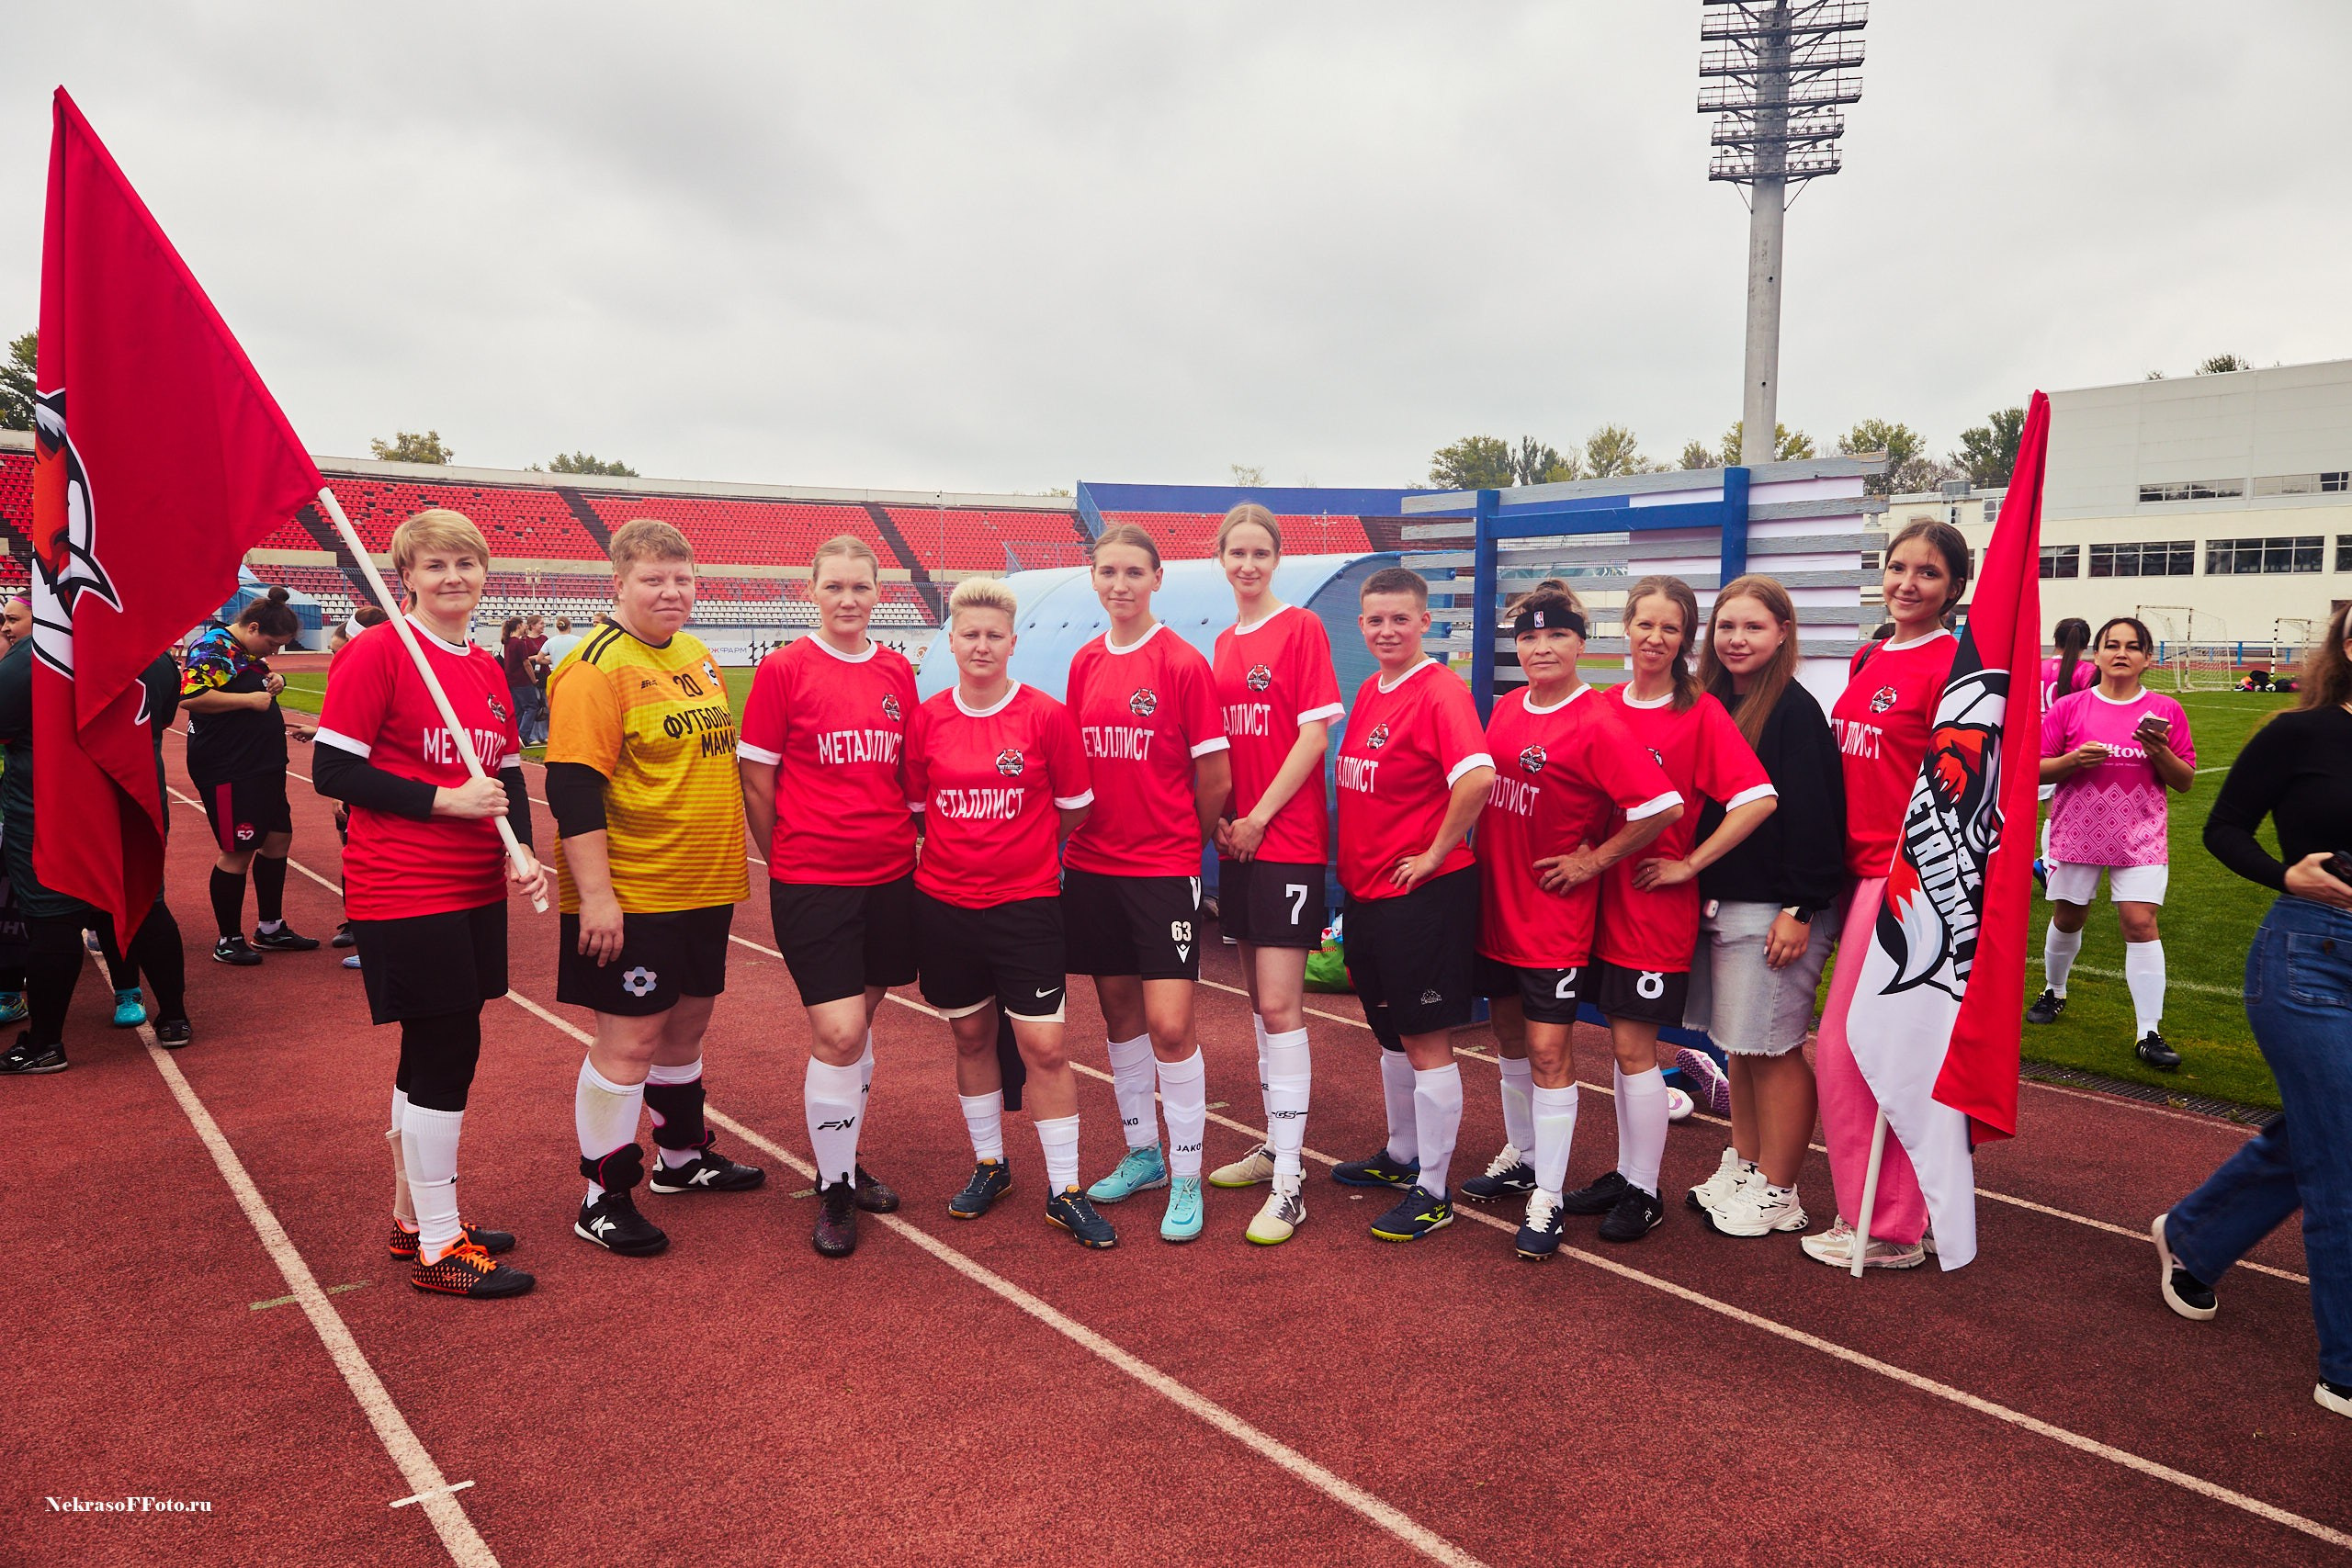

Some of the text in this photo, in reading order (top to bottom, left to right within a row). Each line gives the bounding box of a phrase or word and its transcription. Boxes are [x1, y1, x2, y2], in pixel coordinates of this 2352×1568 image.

[673, 673, 704, 697] 20
[1220, 703, 1271, 736] АЛЛИСТ
[237, 829, 254, 840] 52
[1285, 884, 1308, 925] 7
[1170, 920, 1192, 942] 63
[1555, 967, 1577, 999] 2
[1636, 970, 1665, 999] 8
[1176, 1143, 1203, 1154] JAKO
